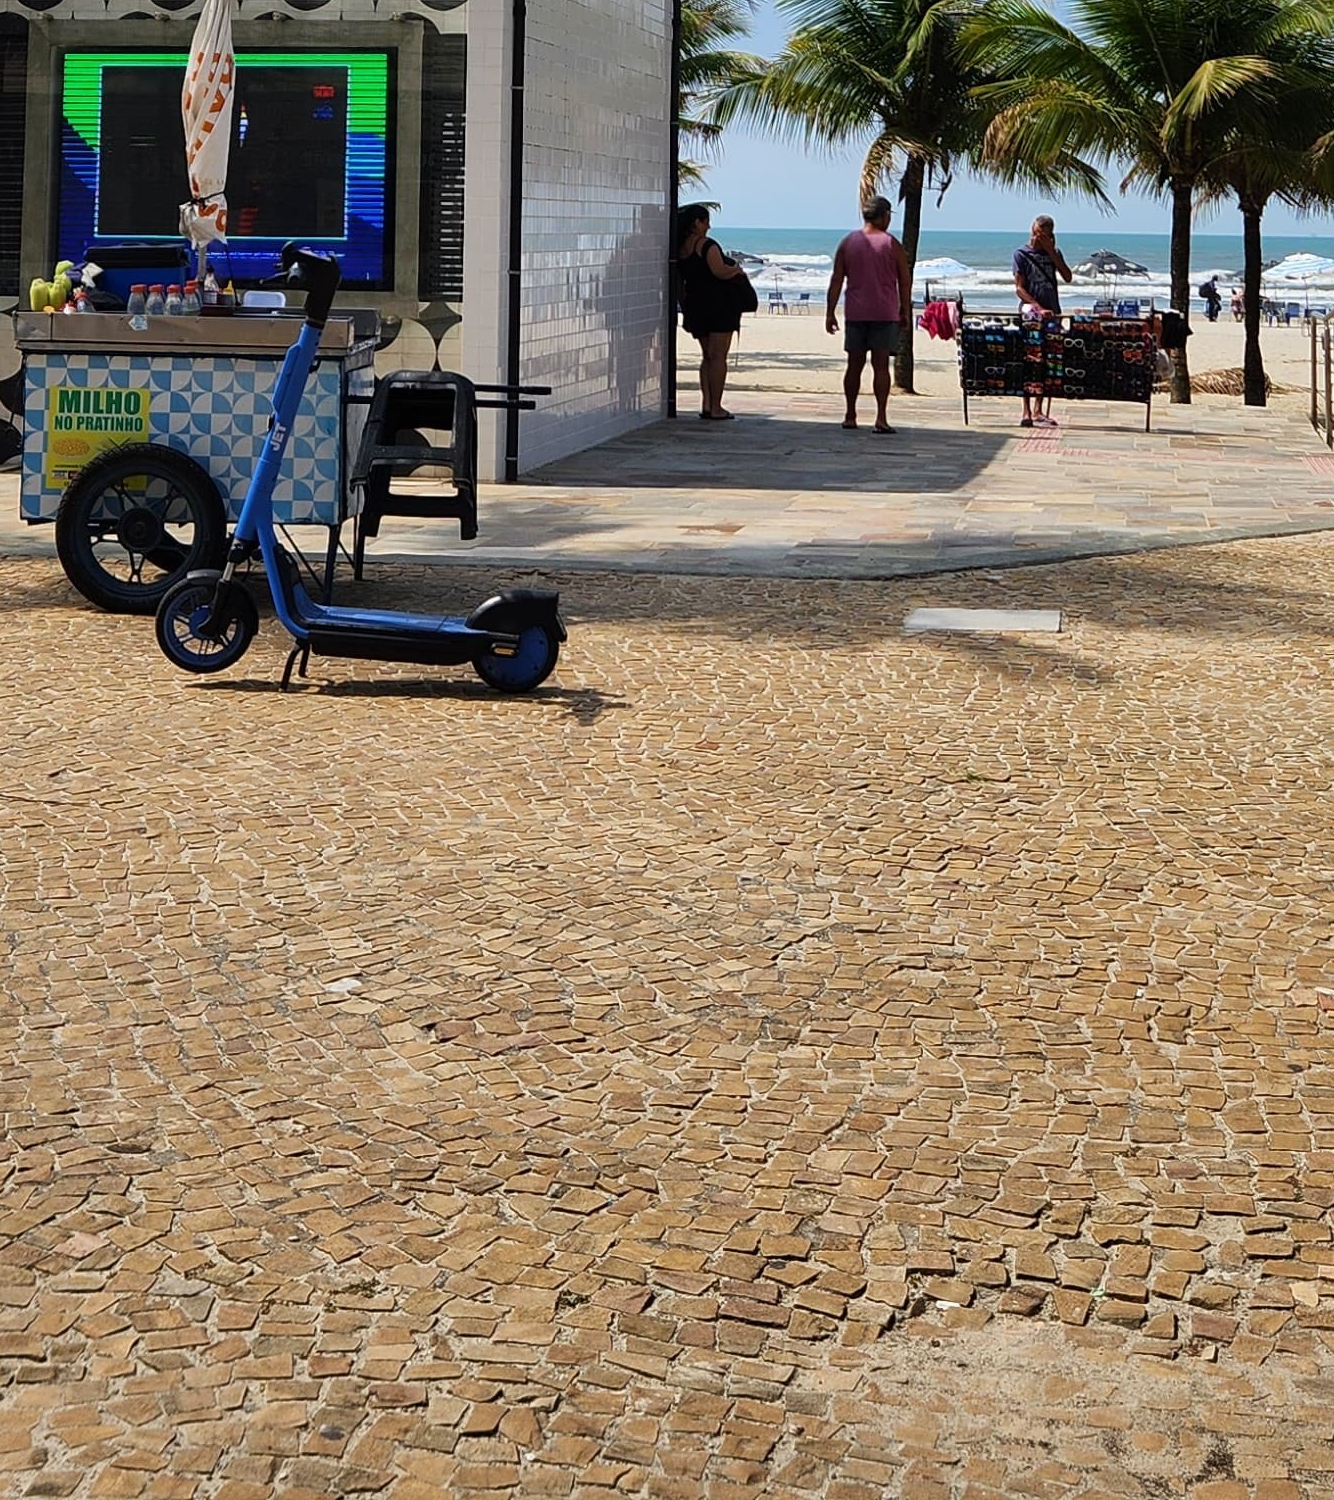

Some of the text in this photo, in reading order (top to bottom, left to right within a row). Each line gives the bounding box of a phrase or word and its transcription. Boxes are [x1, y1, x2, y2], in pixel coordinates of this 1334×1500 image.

[58, 390, 141, 415] MILHO
[54, 415, 143, 432] NO PRATINHO
[270, 422, 286, 451] JET
